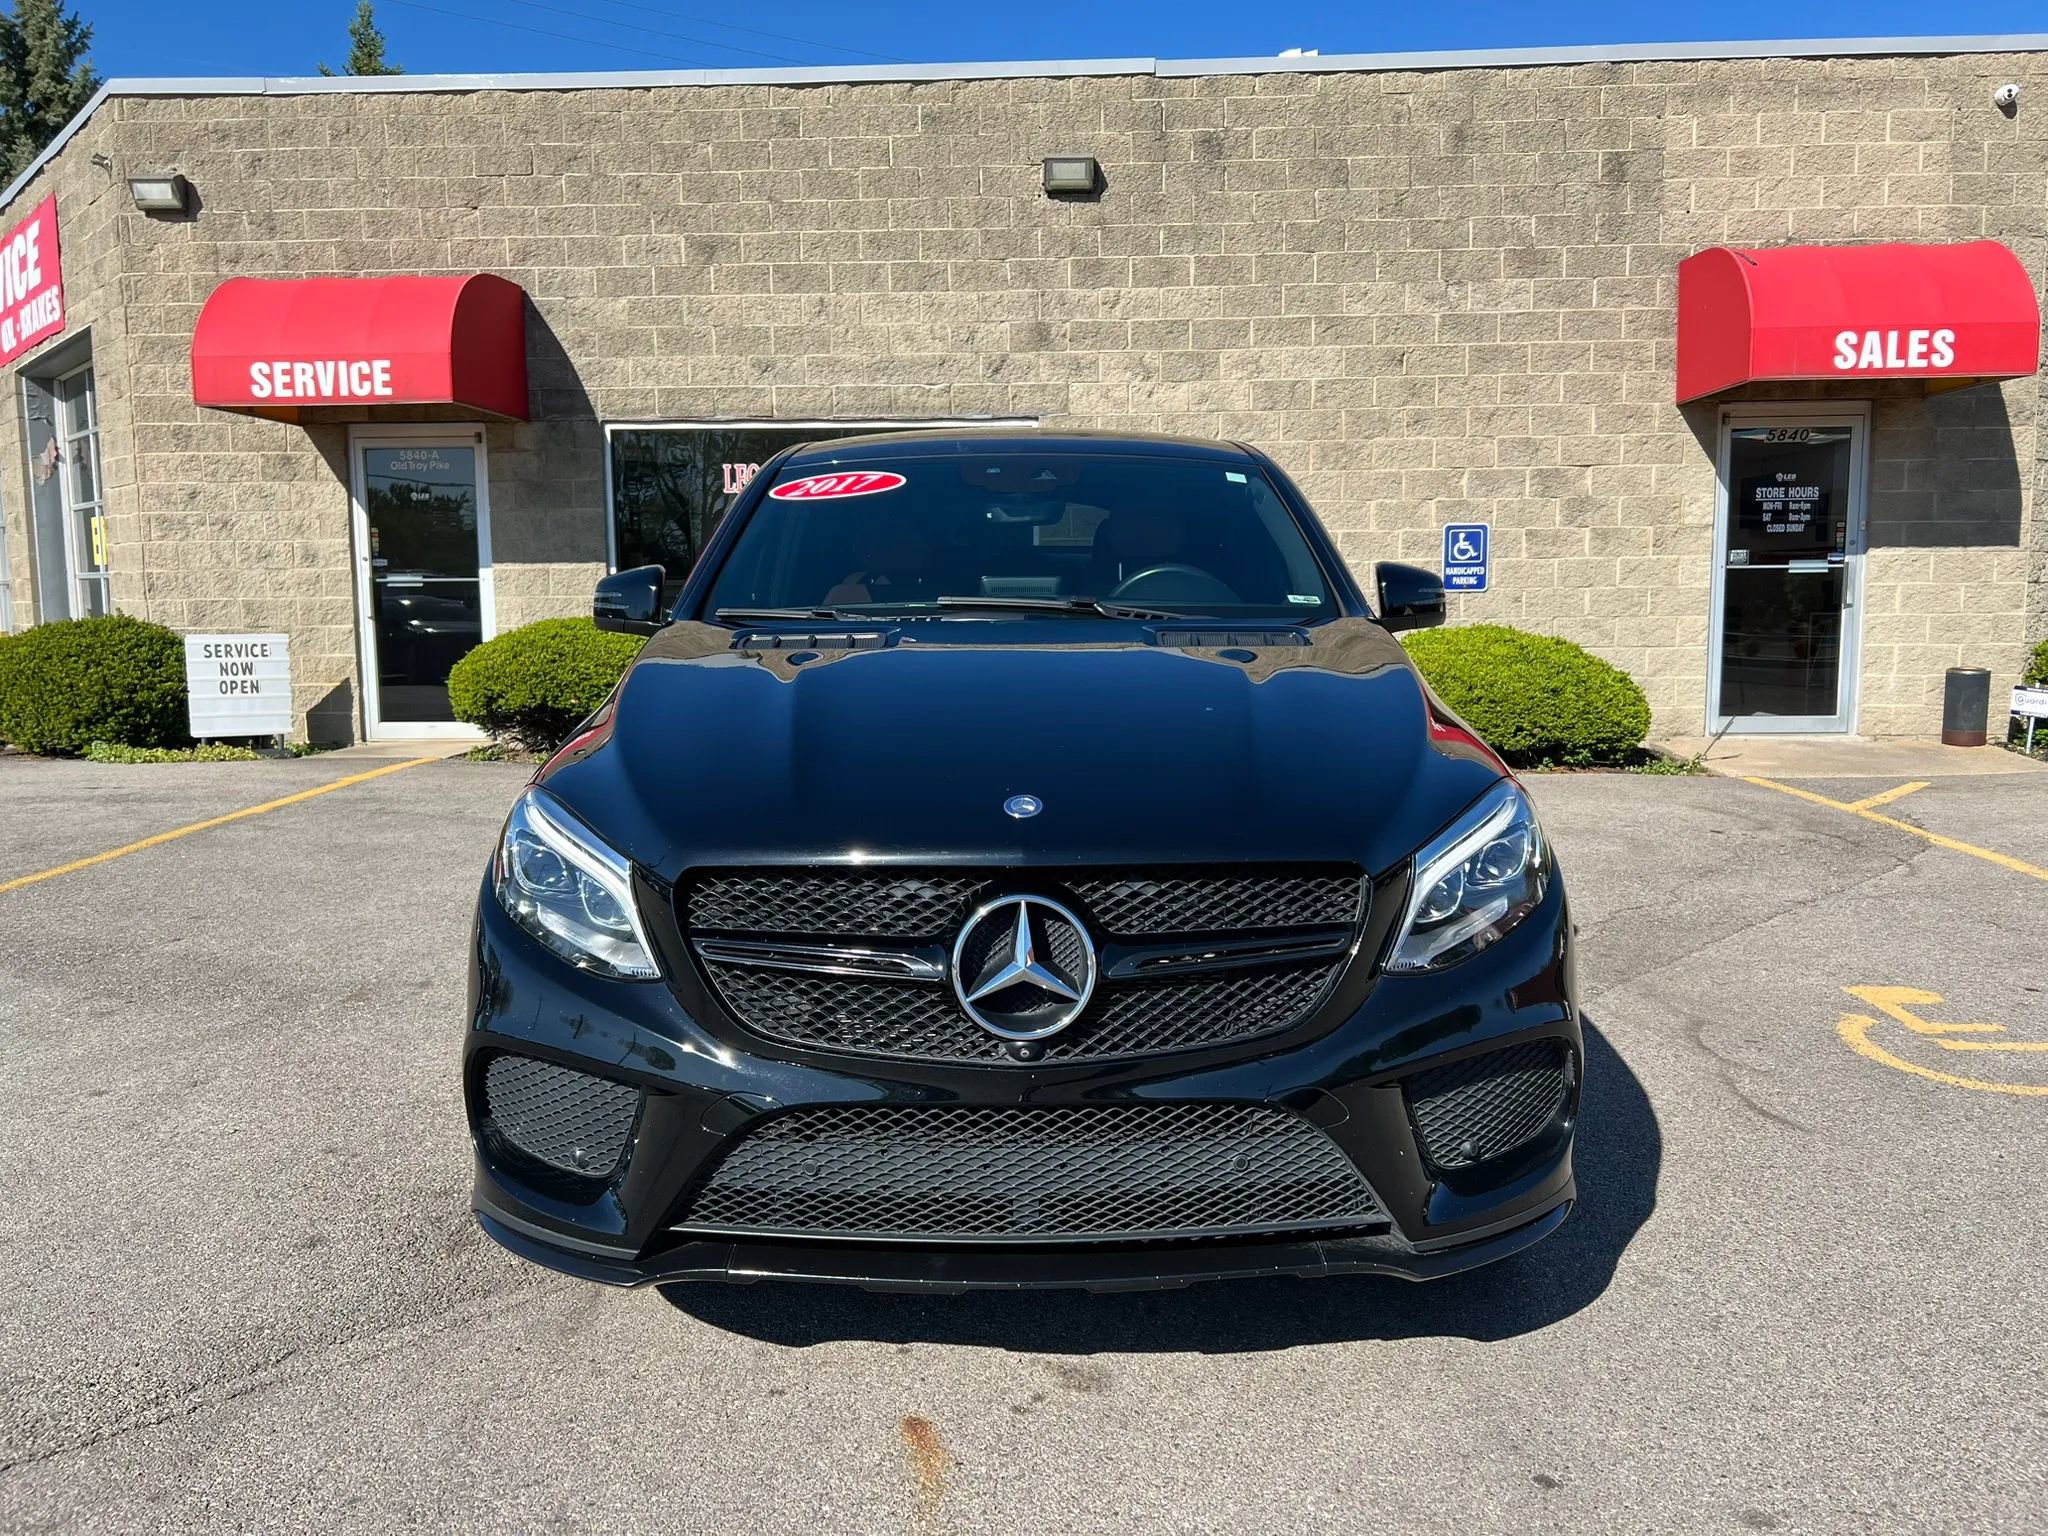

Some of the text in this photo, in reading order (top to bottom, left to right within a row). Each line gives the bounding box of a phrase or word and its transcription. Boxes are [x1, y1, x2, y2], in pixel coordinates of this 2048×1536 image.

[20, 285, 60, 341] BRAKES
[1833, 328, 1956, 370] SALES
[249, 359, 393, 398] SERVICE
[1766, 428, 1810, 441] 5840
[399, 450, 440, 460] 5840-A
[390, 460, 450, 472] Old Troy Pike
[784, 474, 884, 497] 2017
[1755, 486, 1820, 498] STORE HOURS
[1762, 512, 1772, 521] SAT
[1766, 523, 1805, 533] CLOSED SUNDAY
[1446, 567, 1485, 575] HANDICAPPED
[1453, 576, 1478, 585] PARKING
[203, 643, 269, 658] SERVICE
[219, 661, 254, 677] NOW
[219, 680, 260, 694] OPEN
